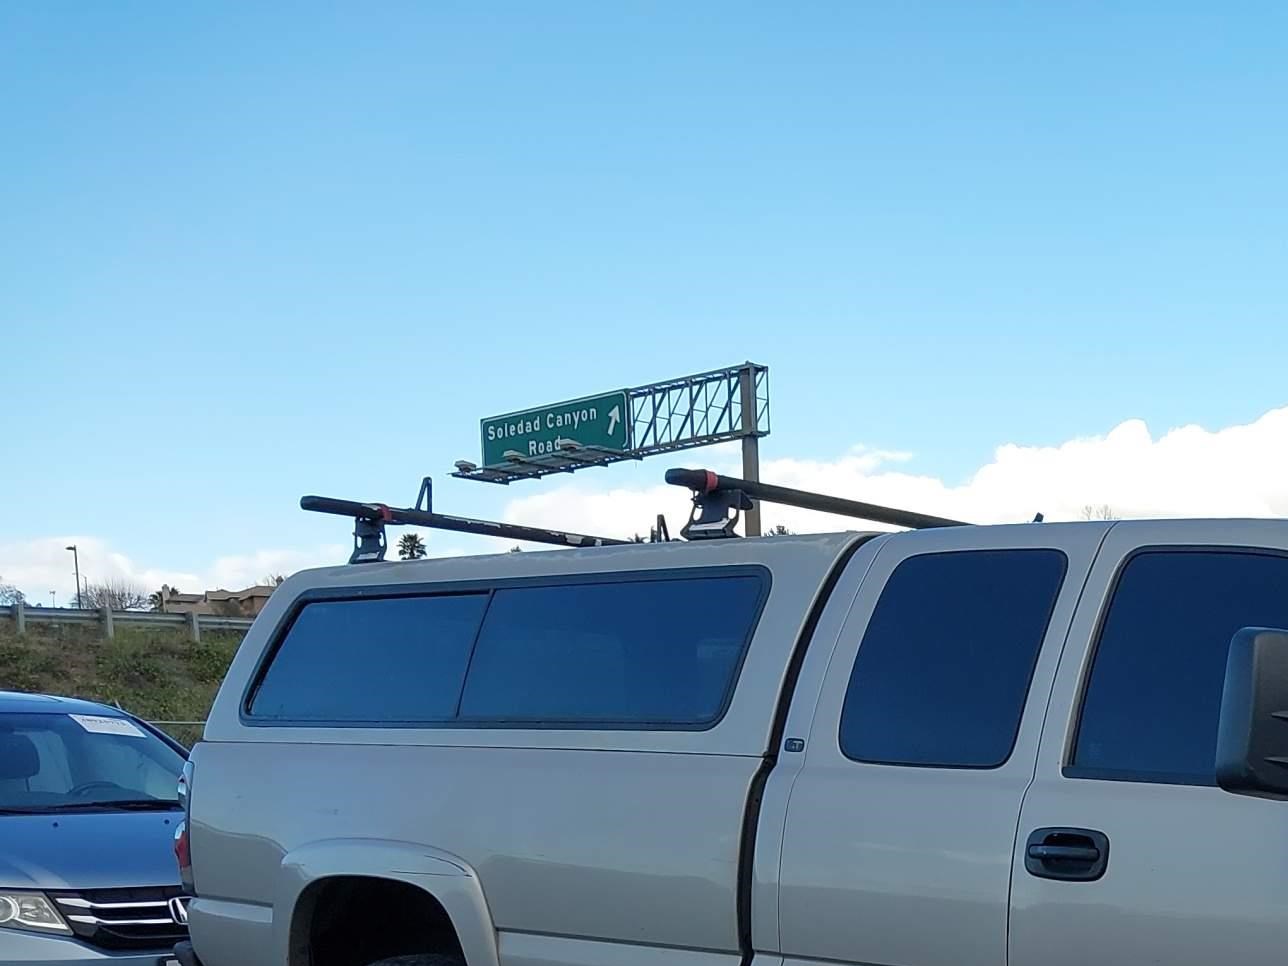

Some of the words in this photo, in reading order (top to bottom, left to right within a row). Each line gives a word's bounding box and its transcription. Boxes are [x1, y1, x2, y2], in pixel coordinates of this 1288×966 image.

[488, 416, 540, 440] Soledad
[546, 408, 597, 430] Canyon
[528, 435, 561, 456] Road
